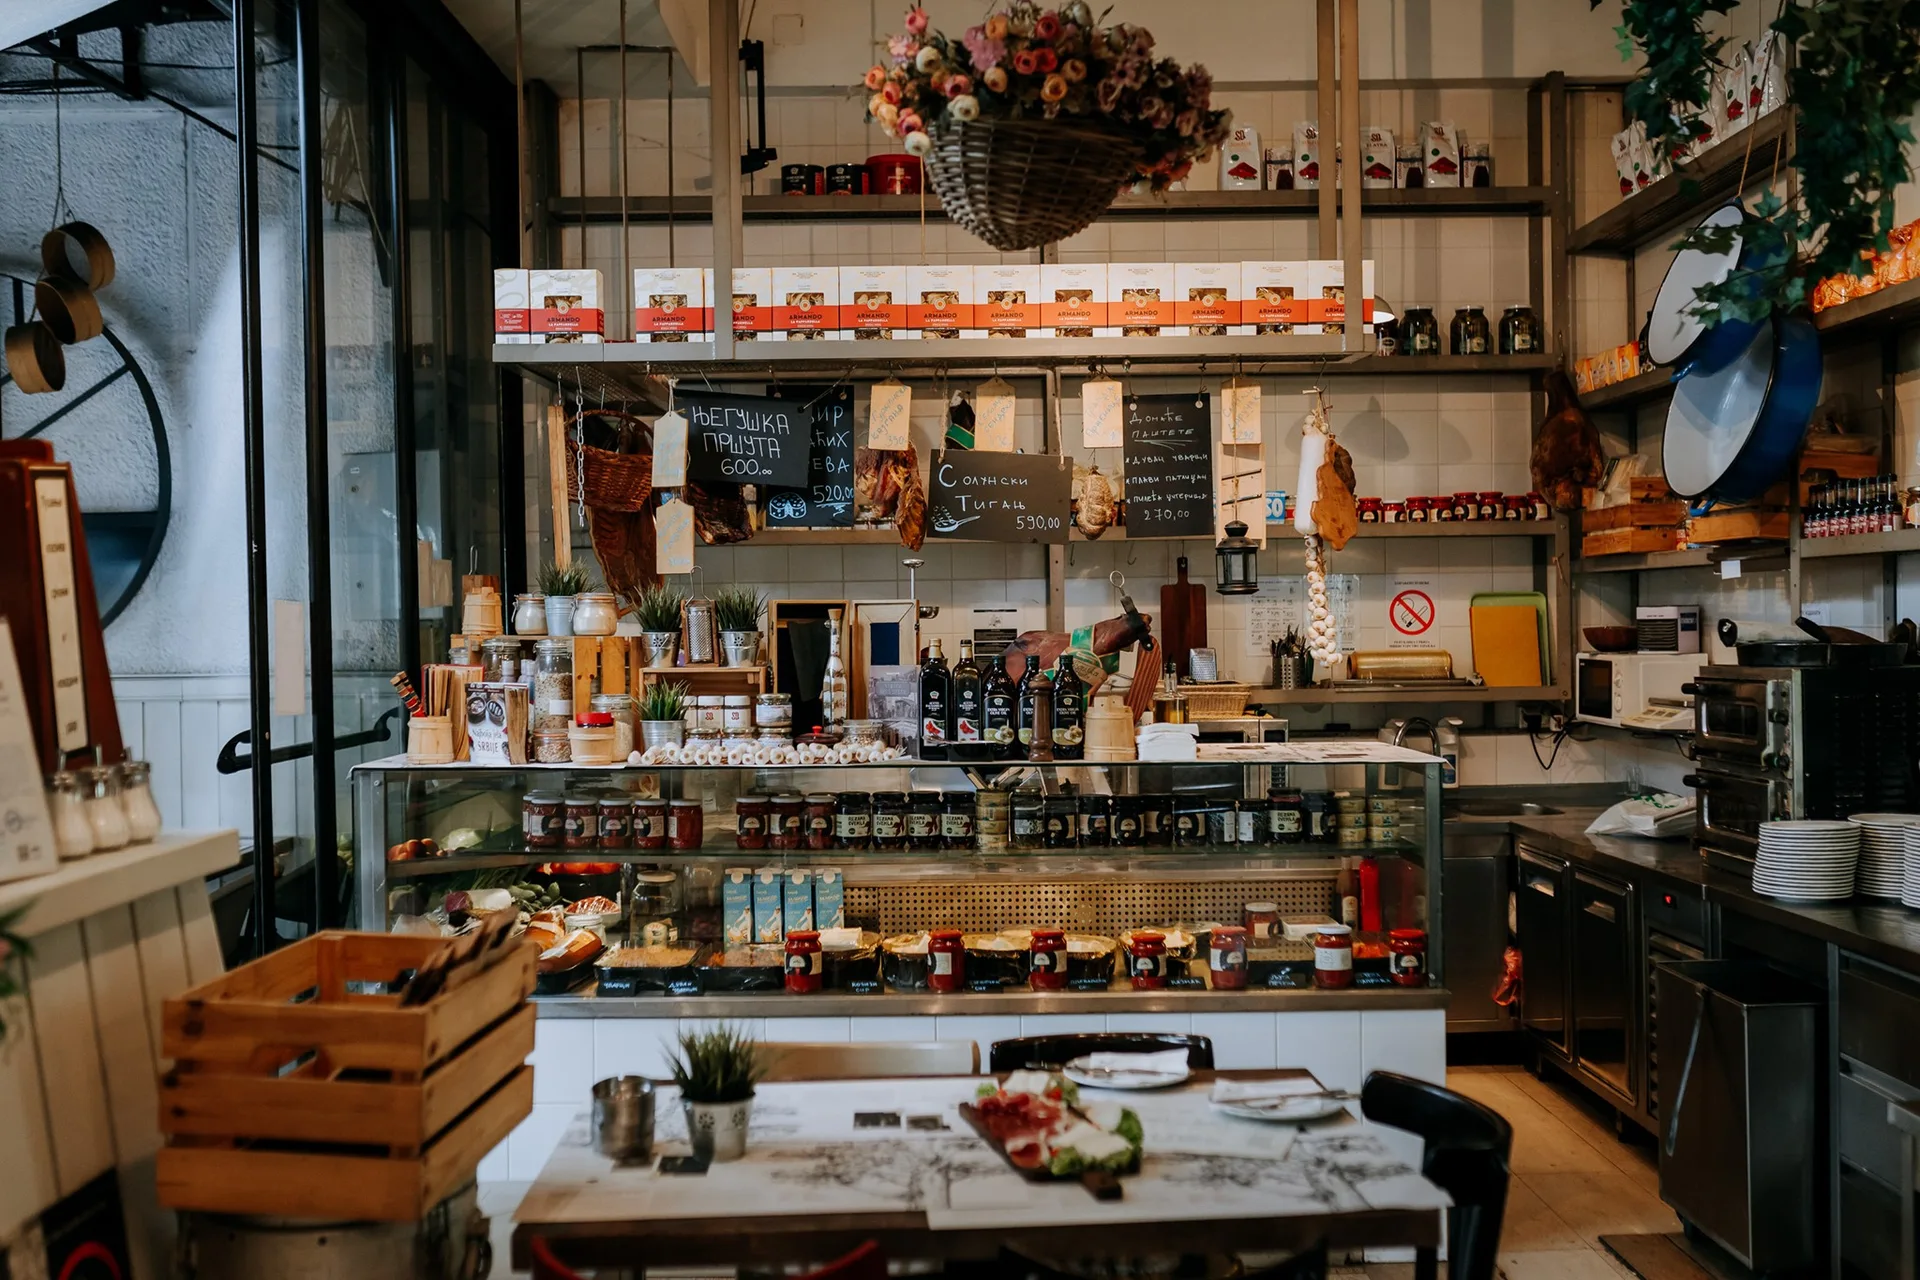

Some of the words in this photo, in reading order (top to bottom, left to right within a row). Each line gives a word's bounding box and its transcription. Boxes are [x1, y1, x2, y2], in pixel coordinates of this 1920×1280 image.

[692, 405, 790, 435] ЊЕГУШКА
[811, 405, 844, 427] ИР
[703, 432, 781, 459] ПРШУТА
[1016, 515, 1060, 531] 590,00
[478, 741, 499, 753] SRBIJE
